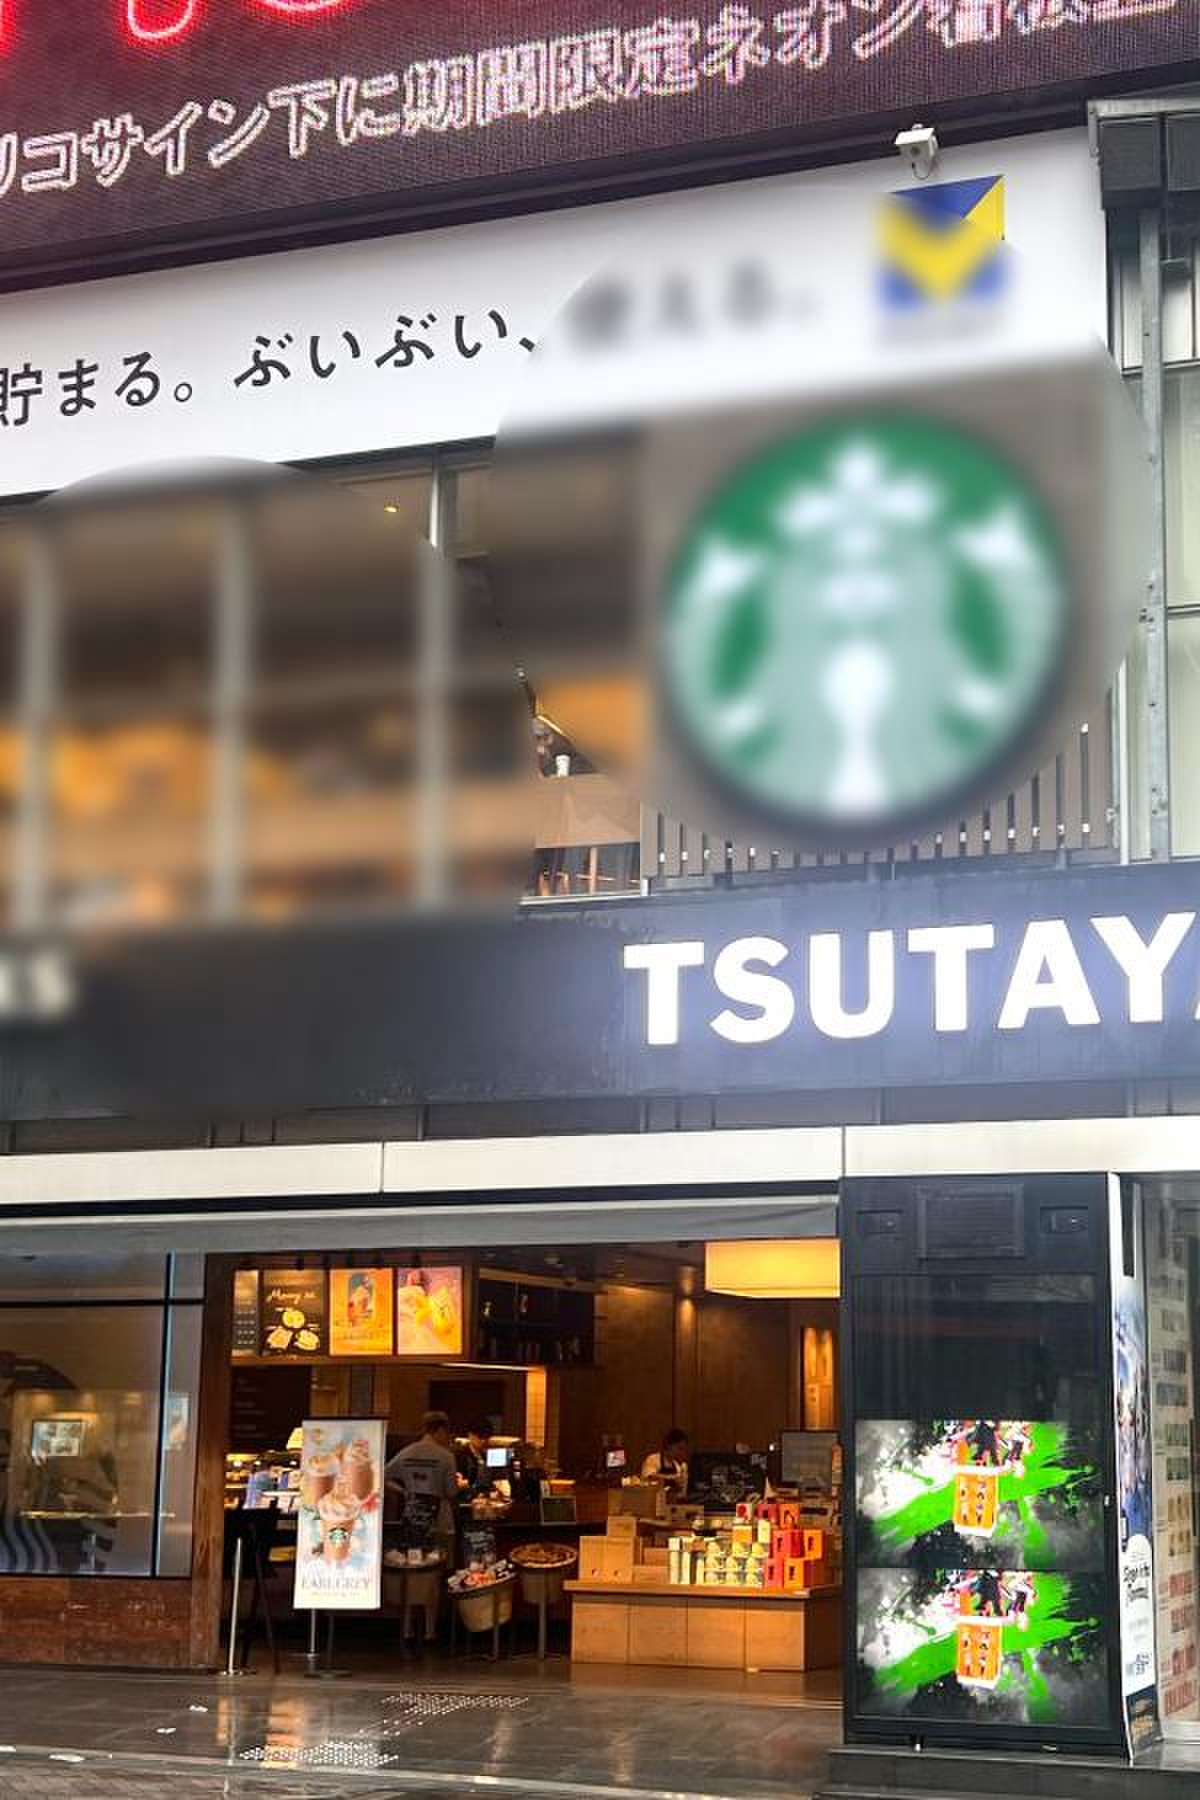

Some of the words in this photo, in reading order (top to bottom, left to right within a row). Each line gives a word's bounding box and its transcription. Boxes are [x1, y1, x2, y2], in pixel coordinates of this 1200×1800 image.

[0, 0, 1175, 195] コサイン下に期間限定ネオン看
